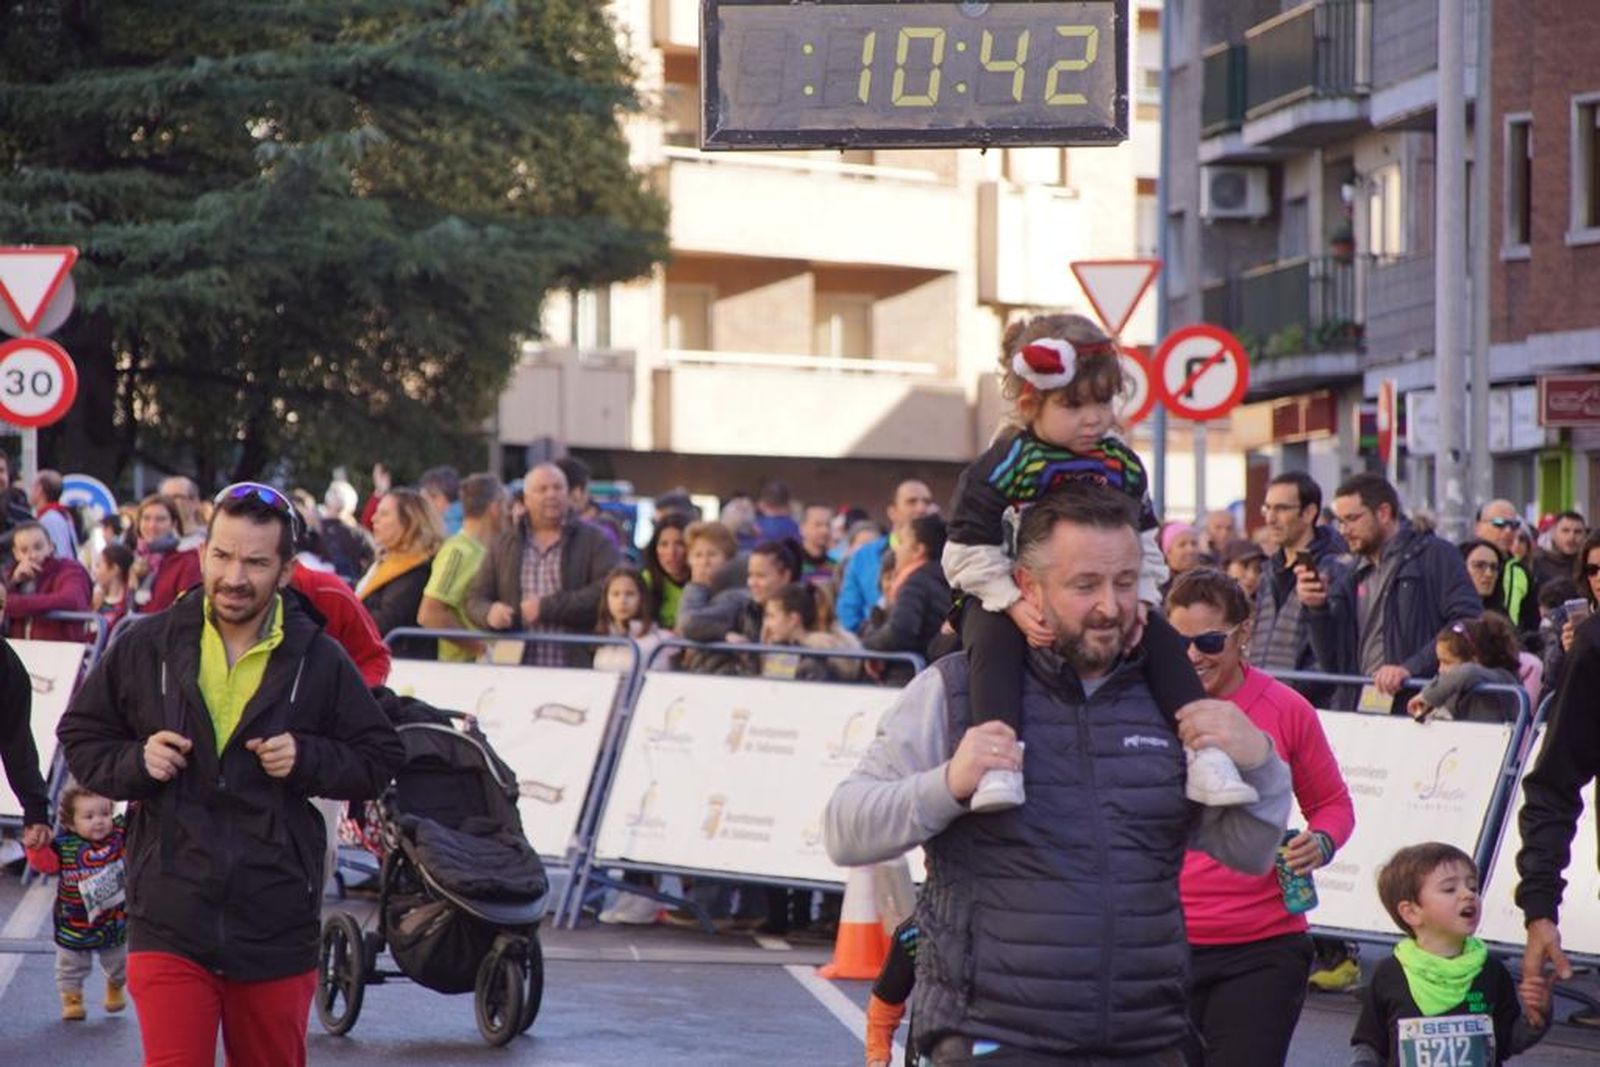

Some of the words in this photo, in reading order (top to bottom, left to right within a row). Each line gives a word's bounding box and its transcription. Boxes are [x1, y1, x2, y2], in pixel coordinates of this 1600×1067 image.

[6, 369, 53, 397] 30
[1422, 1020, 1484, 1035] SETEL
[1414, 1036, 1474, 1067] 6212
